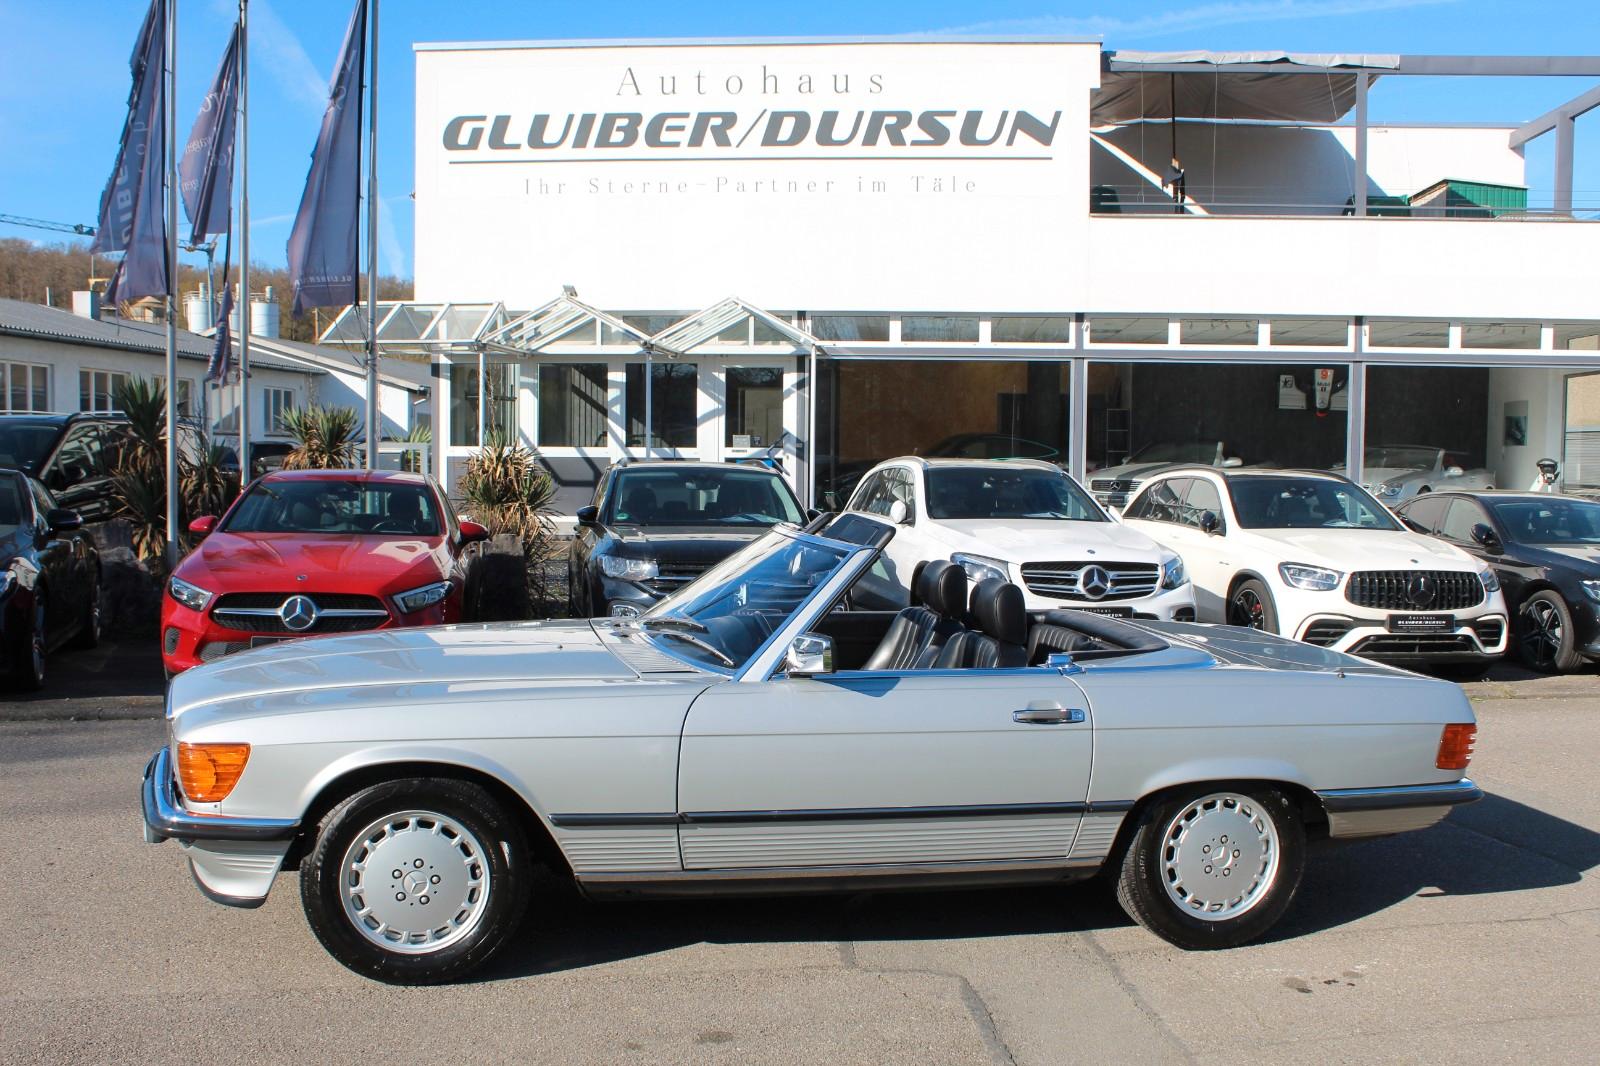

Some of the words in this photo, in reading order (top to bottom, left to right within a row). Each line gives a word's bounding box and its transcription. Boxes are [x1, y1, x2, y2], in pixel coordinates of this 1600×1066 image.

[616, 65, 883, 97] Autohaus
[442, 108, 1063, 152] GLUIBER/DURSUN
[525, 178, 567, 195] Ihr
[588, 176, 835, 194] Sterne-Partner
[857, 176, 887, 193] im
[910, 175, 977, 193] Täle
